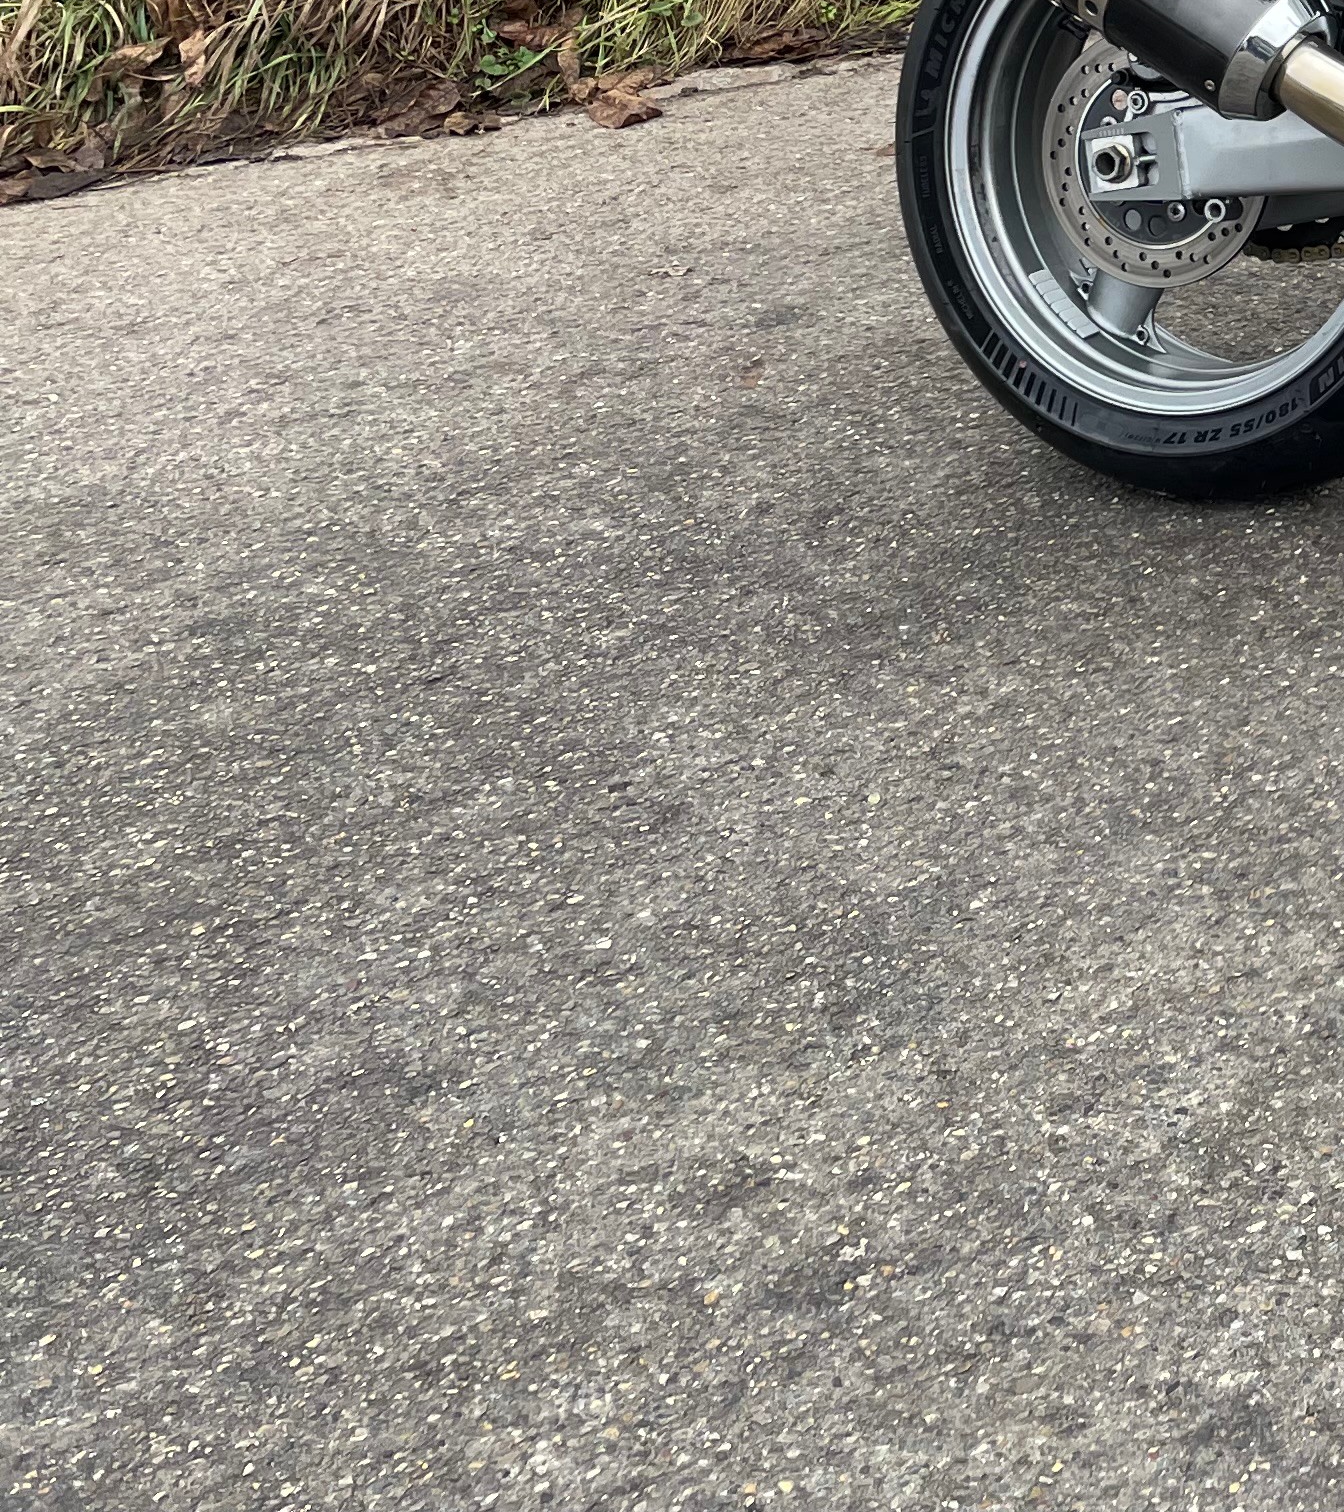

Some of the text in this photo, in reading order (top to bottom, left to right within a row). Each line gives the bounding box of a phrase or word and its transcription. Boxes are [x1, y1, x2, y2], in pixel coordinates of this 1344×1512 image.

[1230, 397, 1299, 437] 180/55
[1162, 430, 1189, 446] 17
[1194, 427, 1223, 444] ZR
